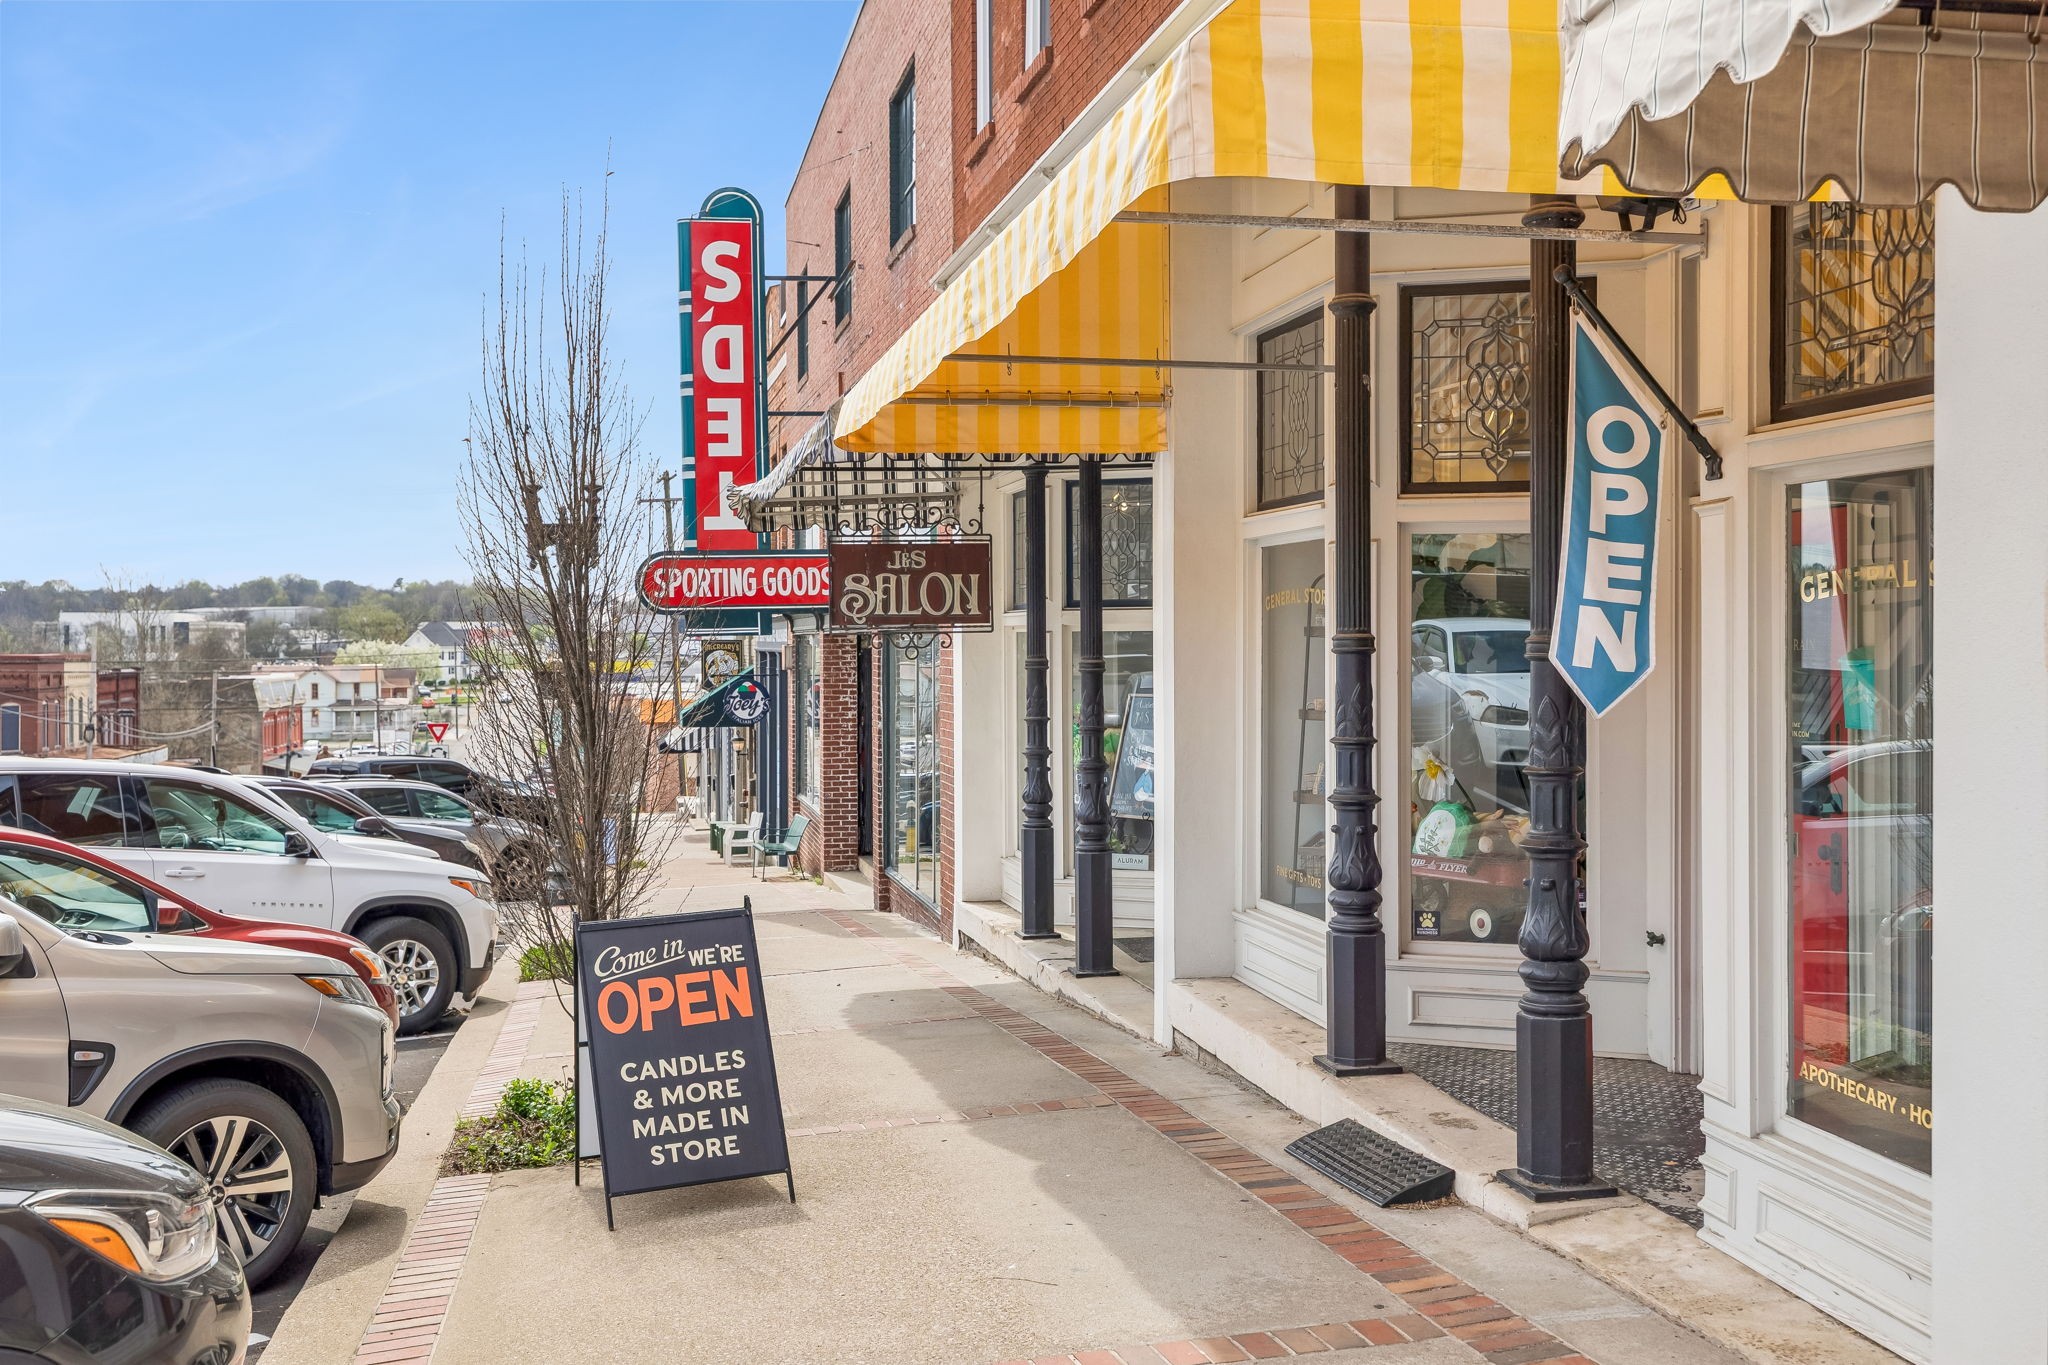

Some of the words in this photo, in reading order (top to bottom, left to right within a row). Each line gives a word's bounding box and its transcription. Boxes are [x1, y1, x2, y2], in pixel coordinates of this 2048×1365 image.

[698, 240, 746, 531] TED'S
[1571, 404, 1651, 673] OPEN
[886, 549, 927, 569] J&S
[653, 566, 758, 598] SPORTING
[762, 566, 830, 597] GOODS
[1800, 559, 1918, 603] GENERAL
[839, 572, 983, 625] SALON
[1265, 588, 1301, 611] GENERAL
[724, 694, 771, 717] Joey's
[732, 714, 752, 724] ITALIAN
[1288, 869, 1304, 883] GIFTS
[1307, 874, 1322, 889] TOYS
[1438, 863, 1468, 874] FLYER
[594, 945, 657, 978] Come
[663, 938, 686, 960] in
[688, 943, 745, 967] WE'RE
[597, 966, 754, 1035] OPEN
[620, 1049, 746, 1083] CANDLES
[633, 1089, 654, 1110] &
[661, 1078, 742, 1107] MORE
[1799, 1061, 1898, 1115] APOTHECARY
[632, 1109, 714, 1139] MADE
[721, 1105, 750, 1128] IN
[650, 1135, 741, 1166] STORE
